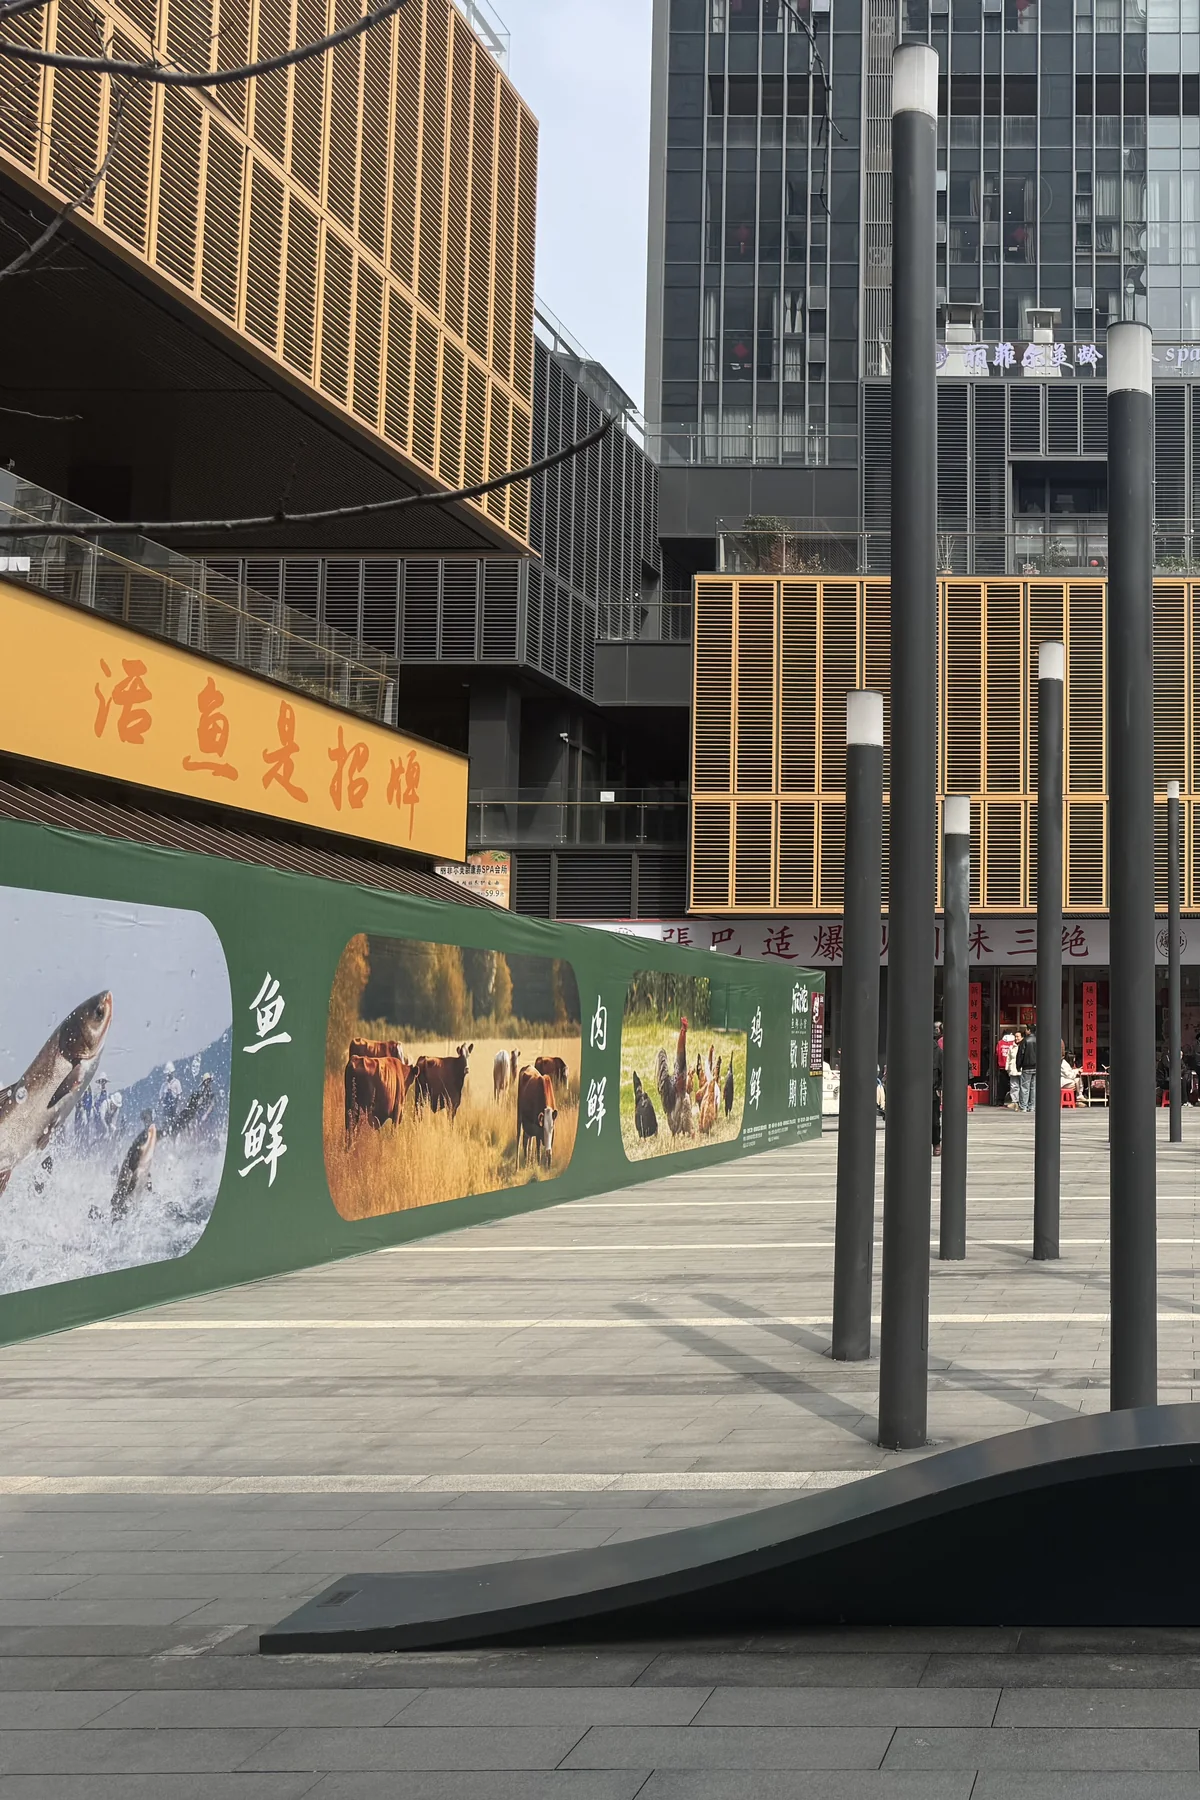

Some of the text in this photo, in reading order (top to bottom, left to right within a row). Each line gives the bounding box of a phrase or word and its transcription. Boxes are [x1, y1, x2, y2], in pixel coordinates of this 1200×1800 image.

[94, 658, 421, 841] 活鱼是招牌
[662, 924, 1089, 961] 張巴适爆味三绝
[238, 971, 292, 1188] 鱼鲜
[586, 995, 607, 1136] 肉鲜
[748, 1005, 765, 1111] 鸡鲜
[788, 1077, 808, 1108] 期待
[790, 1039, 809, 1069] 敬请
